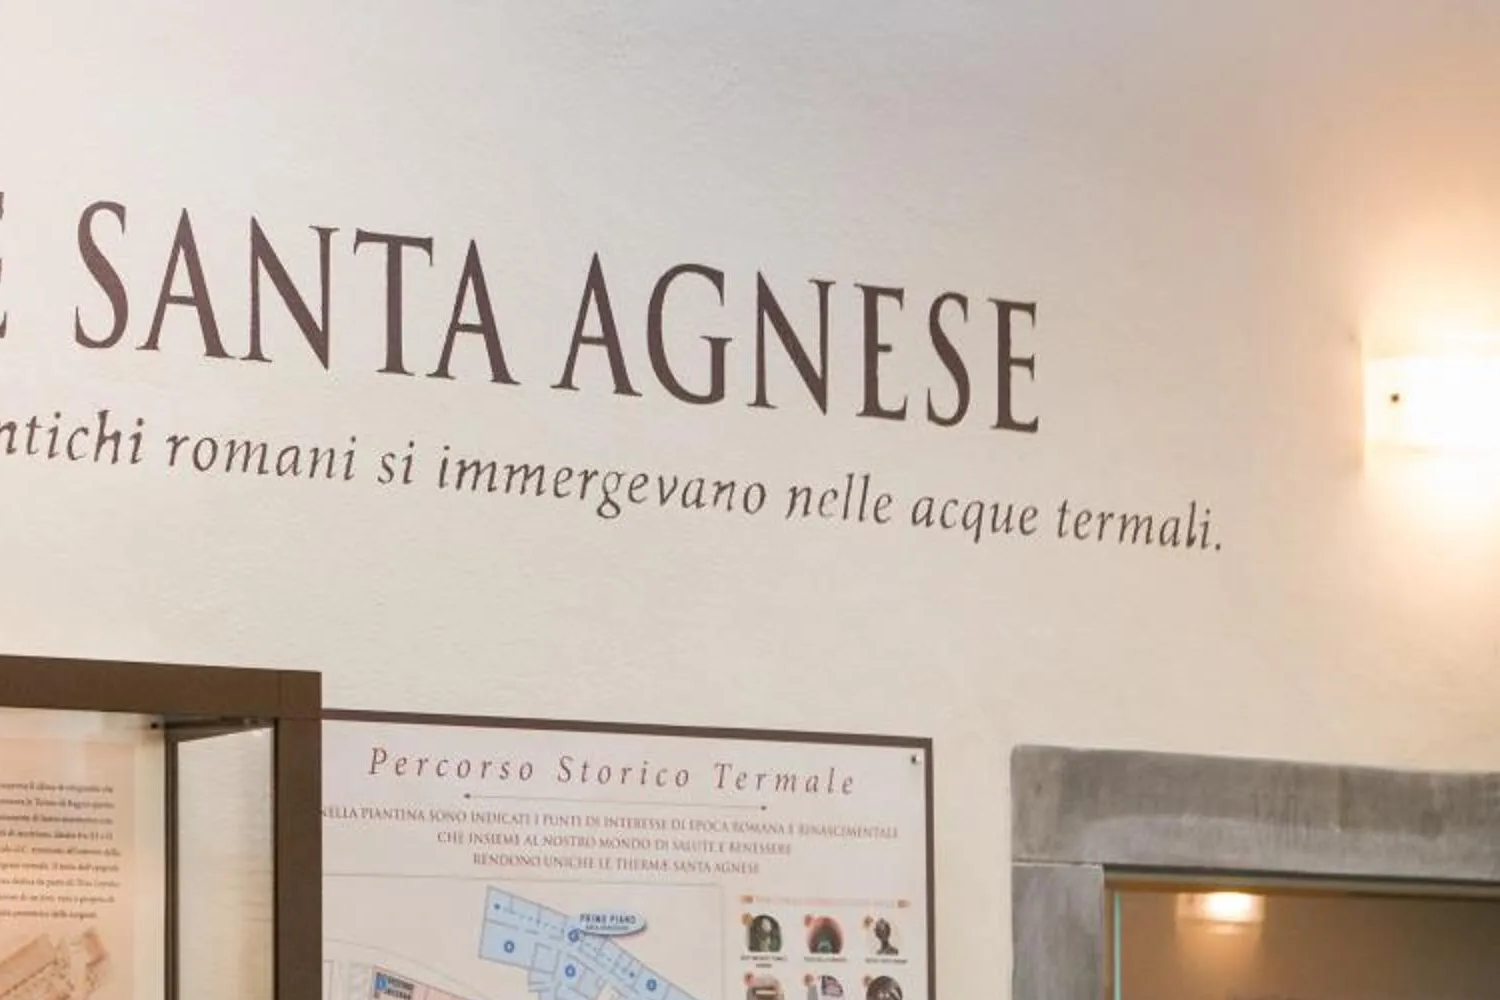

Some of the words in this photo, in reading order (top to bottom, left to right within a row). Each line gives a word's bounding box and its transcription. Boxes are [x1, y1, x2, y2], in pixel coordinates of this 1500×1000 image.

[74, 200, 522, 386] SANTA
[549, 251, 1039, 435] AGNESE
[165, 430, 360, 482] romani
[376, 447, 417, 486] si
[437, 449, 767, 520] immergevano
[784, 472, 893, 525] nelle
[911, 495, 1039, 545] acque
[1057, 499, 1224, 552] termali.
[367, 747, 534, 782] Percorso
[557, 754, 690, 788] Storico
[714, 762, 854, 796] Termale
[360, 806, 425, 822] PIANTINA
[428, 808, 467, 823] SONO
[471, 811, 531, 826] INDICATI
[542, 812, 581, 828] PUNTI
[603, 816, 667, 831] INTERESSE
[671, 818, 686, 832] DI
[437, 831, 464, 844] CHE
[524, 833, 540, 847] AL
[543, 835, 597, 849] NOSTRO
[599, 837, 651, 850] MONDO
[674, 860, 712, 874] SANTA
